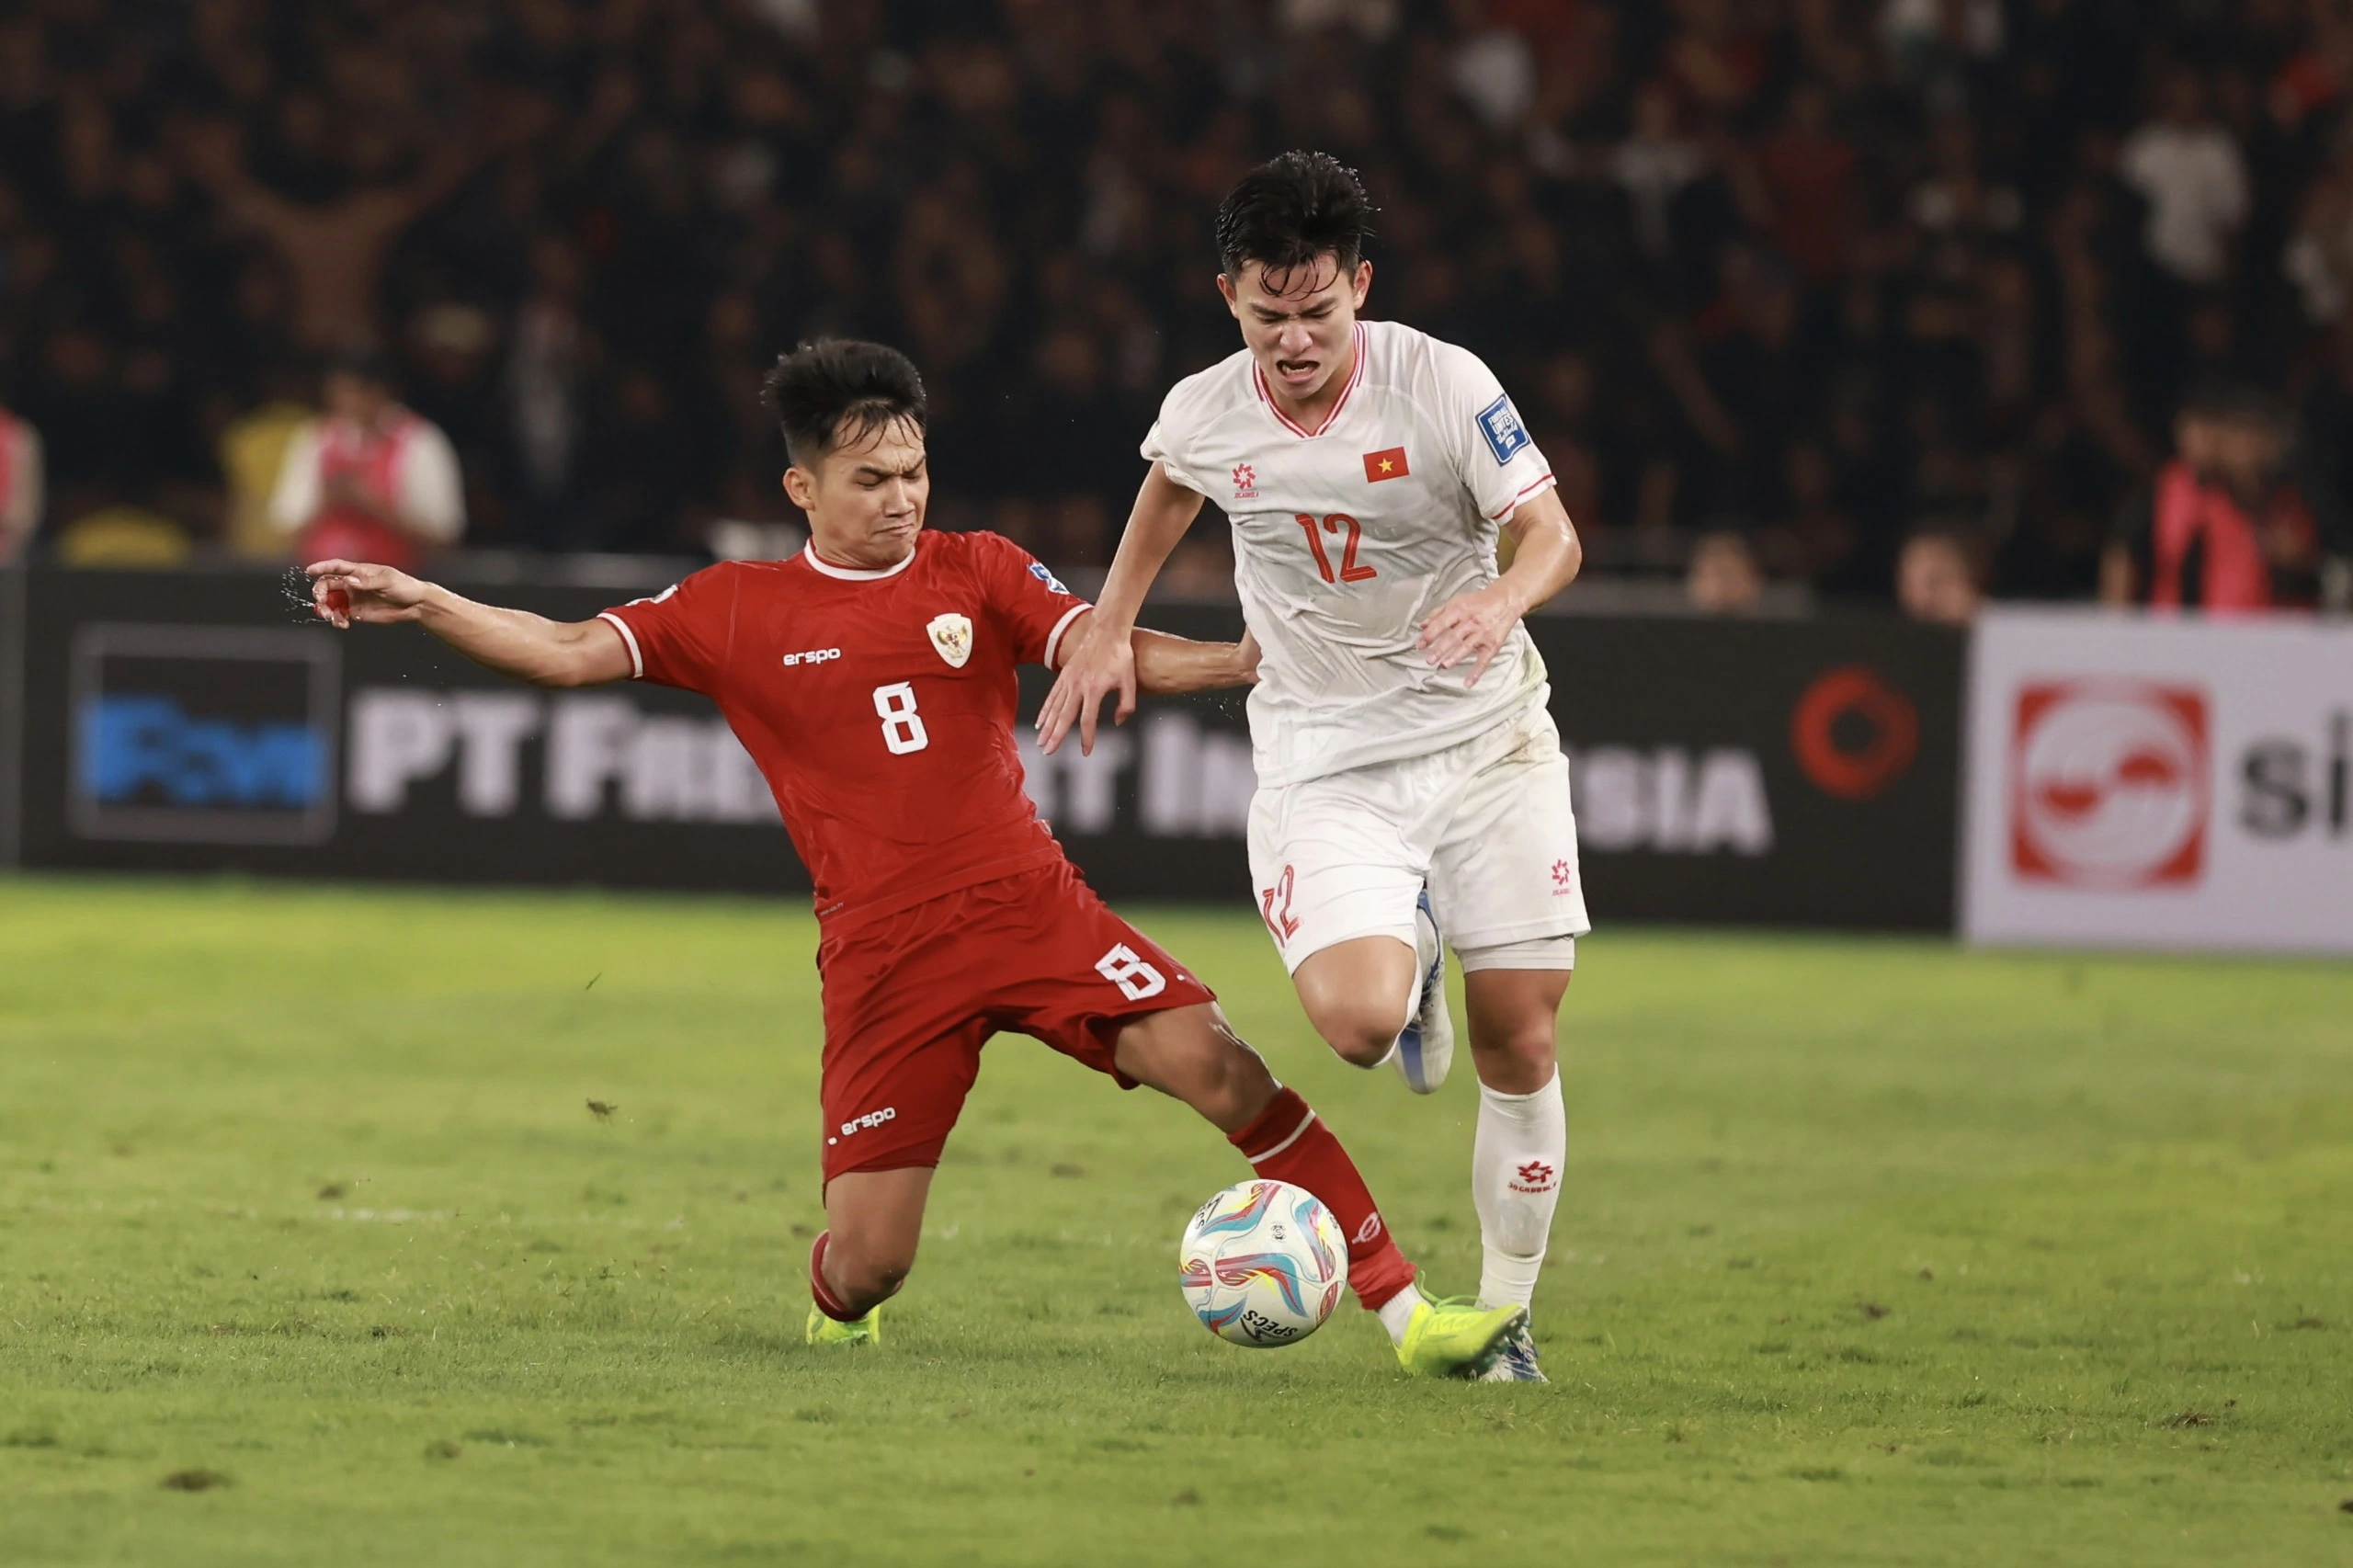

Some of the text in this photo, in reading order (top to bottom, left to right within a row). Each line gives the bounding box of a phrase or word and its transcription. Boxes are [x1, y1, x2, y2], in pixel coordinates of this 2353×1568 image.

[1296, 513, 1377, 584] 12
[783, 647, 842, 666] erspo
[873, 680, 928, 756] 8
[349, 689, 540, 816] PT
[1095, 942, 1166, 1001] 8
[841, 1107, 896, 1135] erspo
[1243, 1310, 1298, 1337] SPECS
